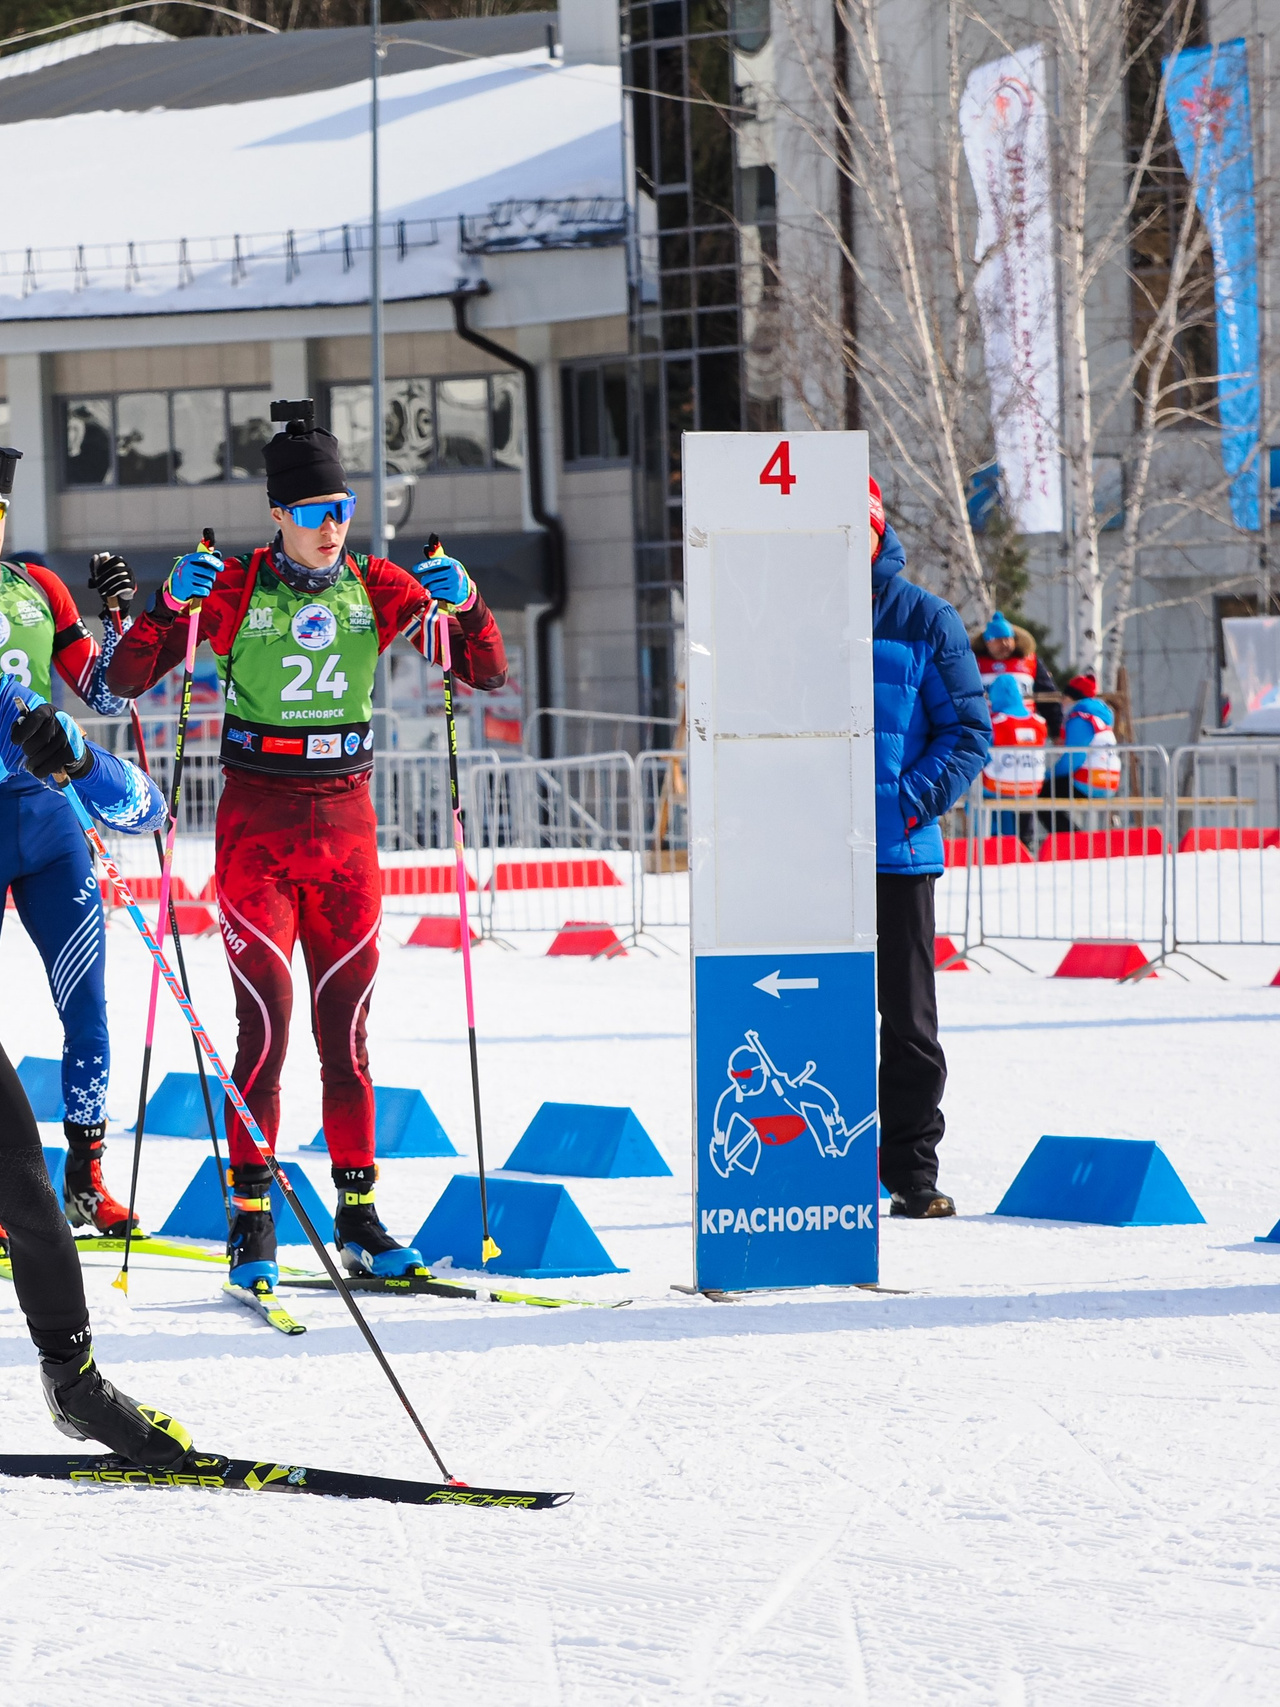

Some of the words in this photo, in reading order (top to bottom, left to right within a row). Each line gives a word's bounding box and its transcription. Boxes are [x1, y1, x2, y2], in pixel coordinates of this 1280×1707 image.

[760, 441, 796, 495] 4
[280, 654, 349, 701] 24
[182, 681, 192, 718] LEKI
[281, 708, 344, 720] КРАСНОЯРСК
[83, 1128, 101, 1138] 178
[345, 1170, 365, 1180] 174
[701, 1204, 874, 1235] КРАСНОЯРСК
[97, 1241, 127, 1249] FISCHE
[384, 1280, 411, 1288] FISCHER
[70, 1470, 225, 1488] FISCHER
[424, 1490, 537, 1508] FISCHER
